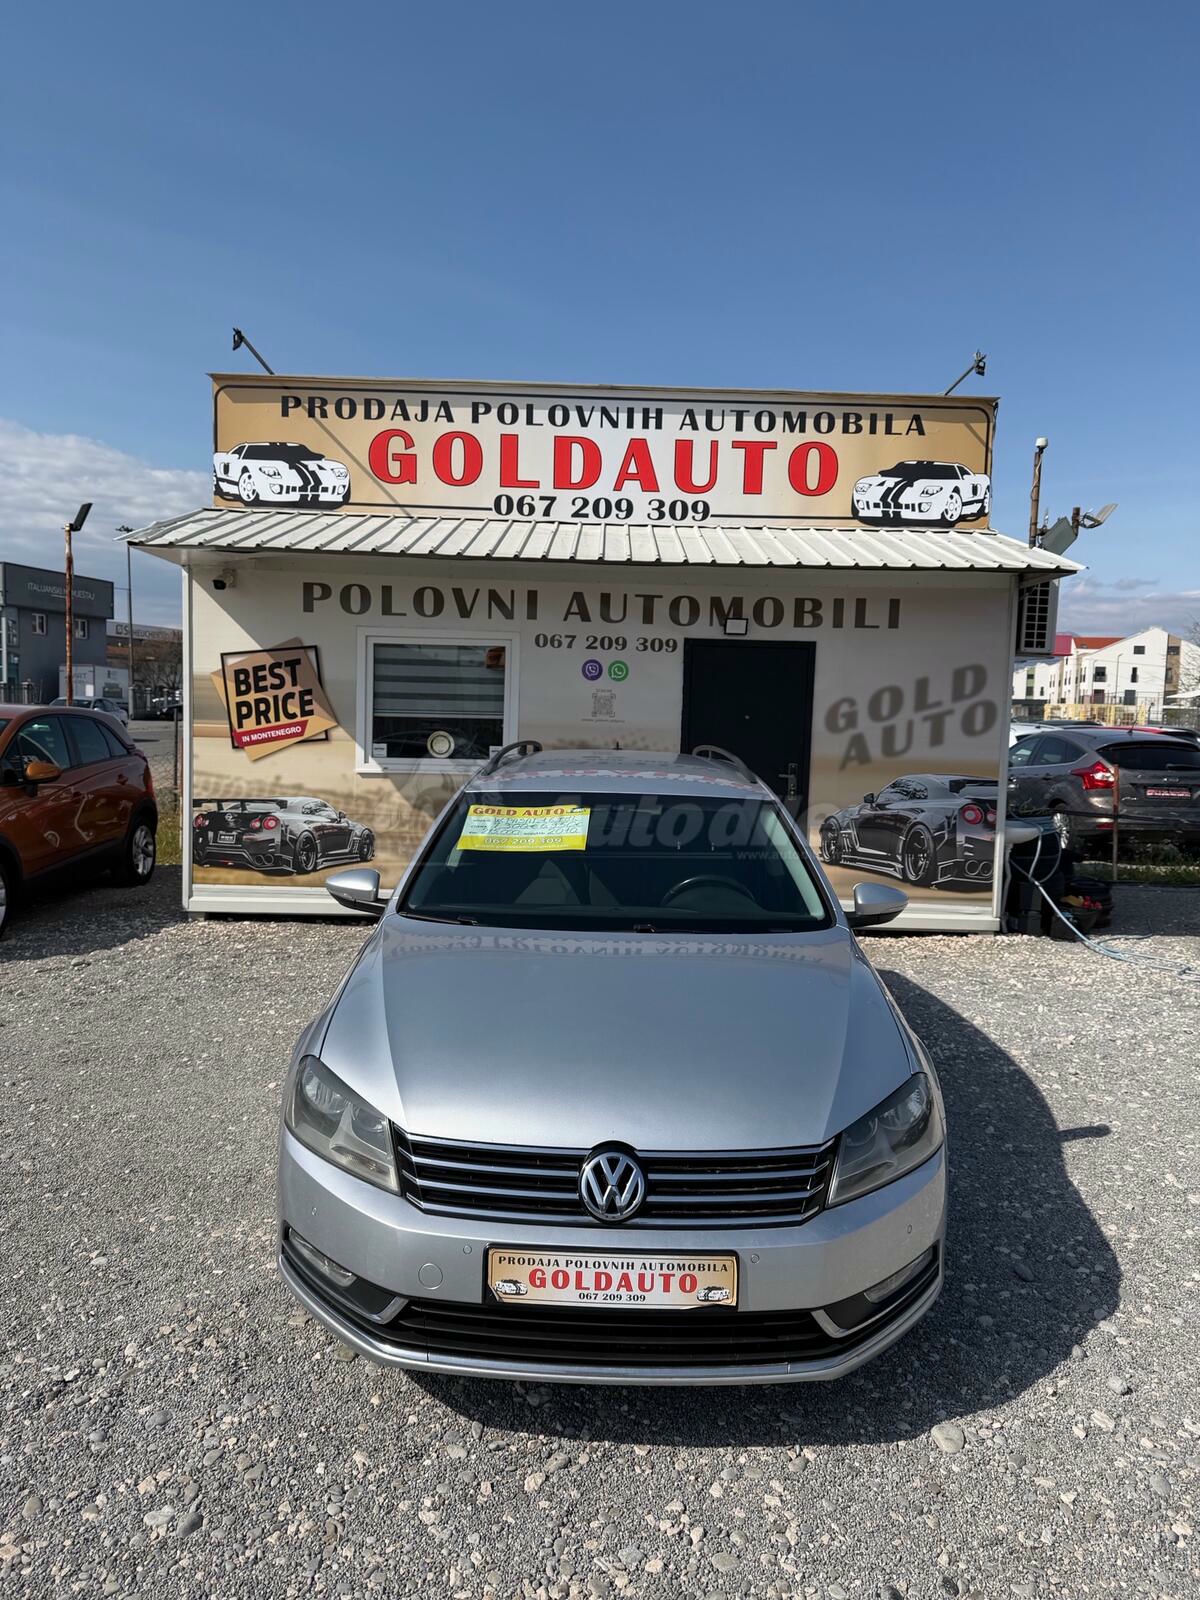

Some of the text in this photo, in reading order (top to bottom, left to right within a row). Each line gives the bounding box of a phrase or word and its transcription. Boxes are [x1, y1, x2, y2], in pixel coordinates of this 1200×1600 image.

[281, 394, 926, 436] PRODAJA POLOVNIH AUTOMOBILA
[368, 428, 839, 496] GOLDAUTO
[493, 494, 711, 522] 067 209 309
[302, 581, 899, 629] POLOVNI AUTOMOBILI
[534, 633, 678, 653] 067 209 309
[234, 658, 302, 697] BEST
[235, 688, 315, 729] PRICE
[824, 664, 988, 734] GOLD
[242, 725, 302, 743] IN MONTENEGRO
[838, 700, 998, 773] AUTO
[472, 807, 565, 817] GOLD AUTO
[498, 1255, 728, 1273] PRODAJA POLOVNIH AUTOMOBILA
[528, 1267, 698, 1294] GOLDAUTO
[578, 1292, 646, 1303] 067 209 309
